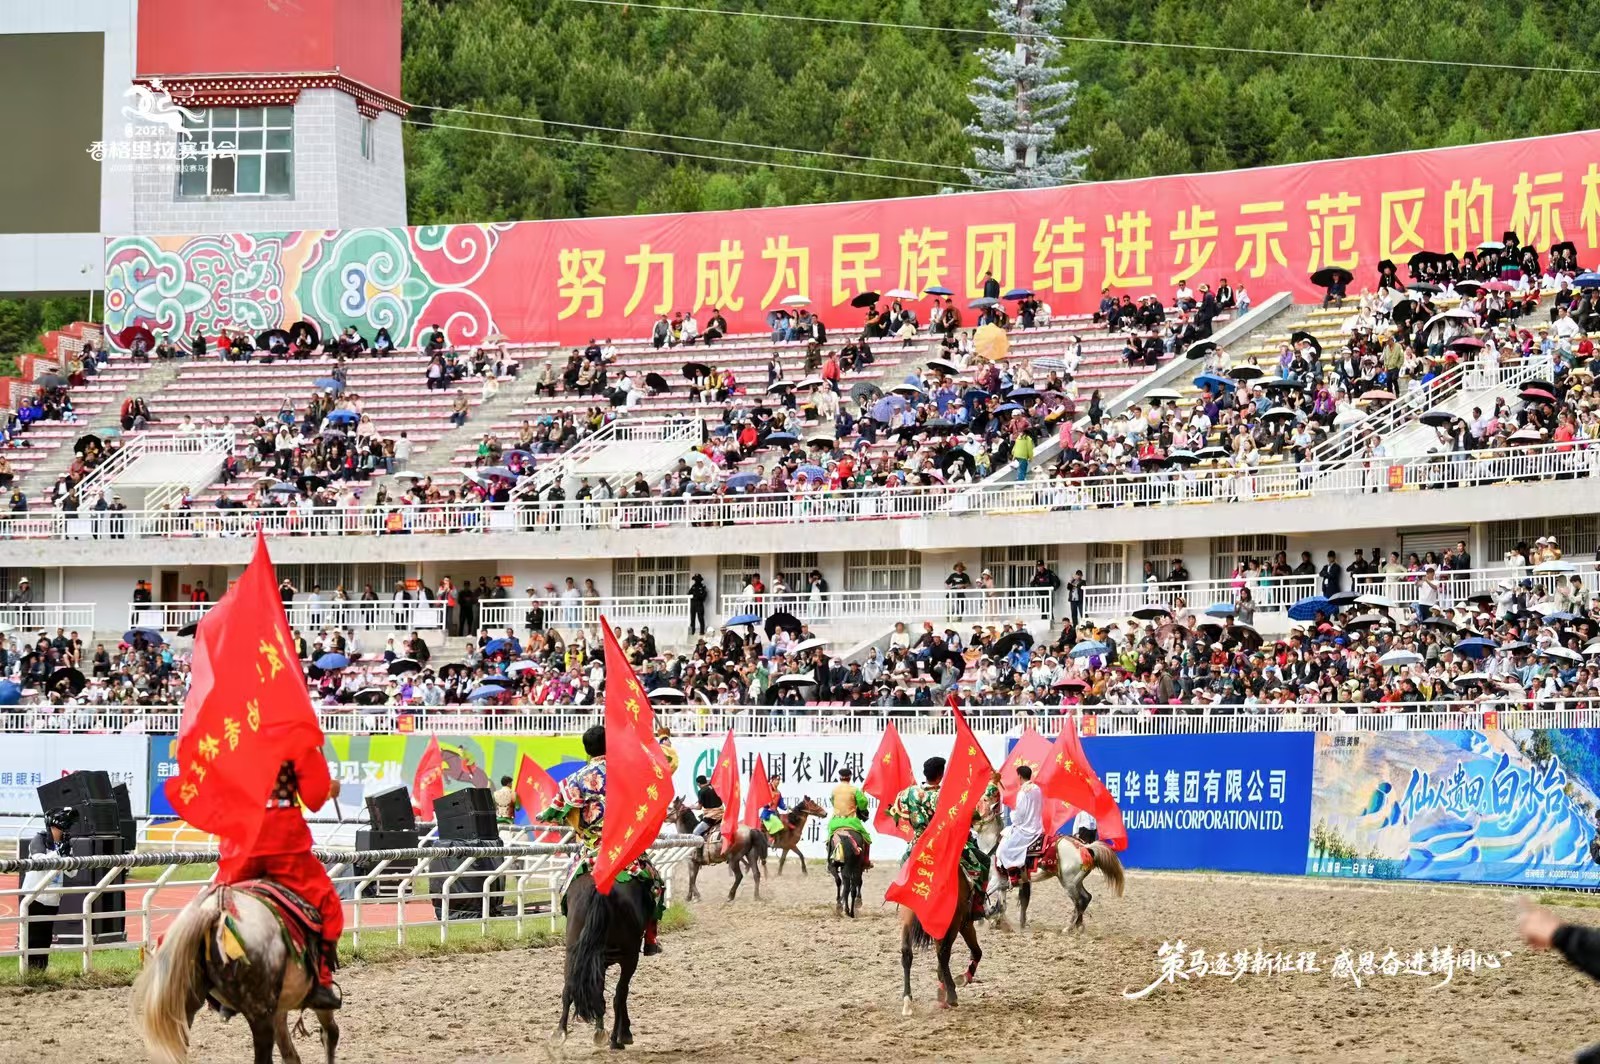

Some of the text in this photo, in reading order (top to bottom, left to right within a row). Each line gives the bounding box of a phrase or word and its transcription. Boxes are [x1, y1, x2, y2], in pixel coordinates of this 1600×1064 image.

[1098, 769, 1286, 804] 国华电集团有限公司
[1123, 809, 1284, 830] HUADIAN CORPORATION LTD.
